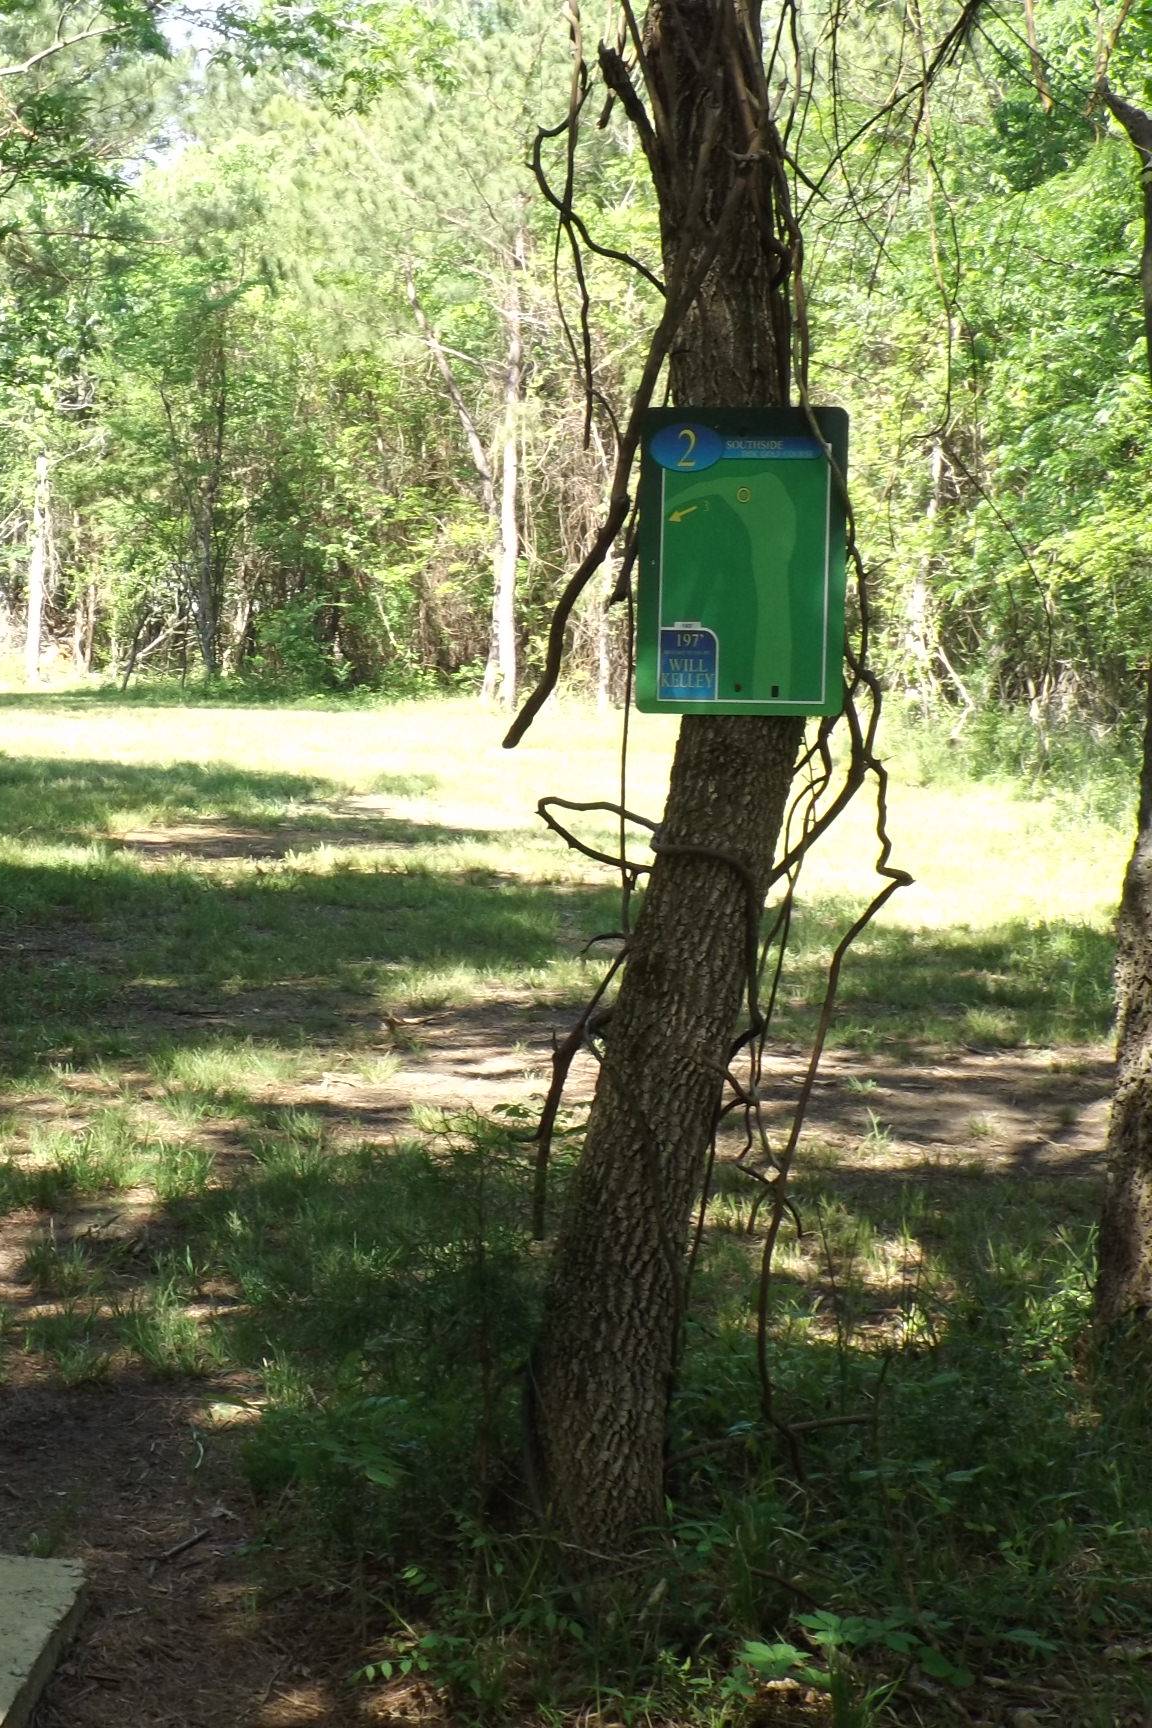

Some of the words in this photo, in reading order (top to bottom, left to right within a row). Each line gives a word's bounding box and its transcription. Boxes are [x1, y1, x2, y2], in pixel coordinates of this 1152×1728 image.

[677, 429, 696, 467] 2
[726, 440, 784, 450] SOUTHSIDE
[669, 658, 708, 672] WILL
[661, 672, 716, 688] KELLEY
